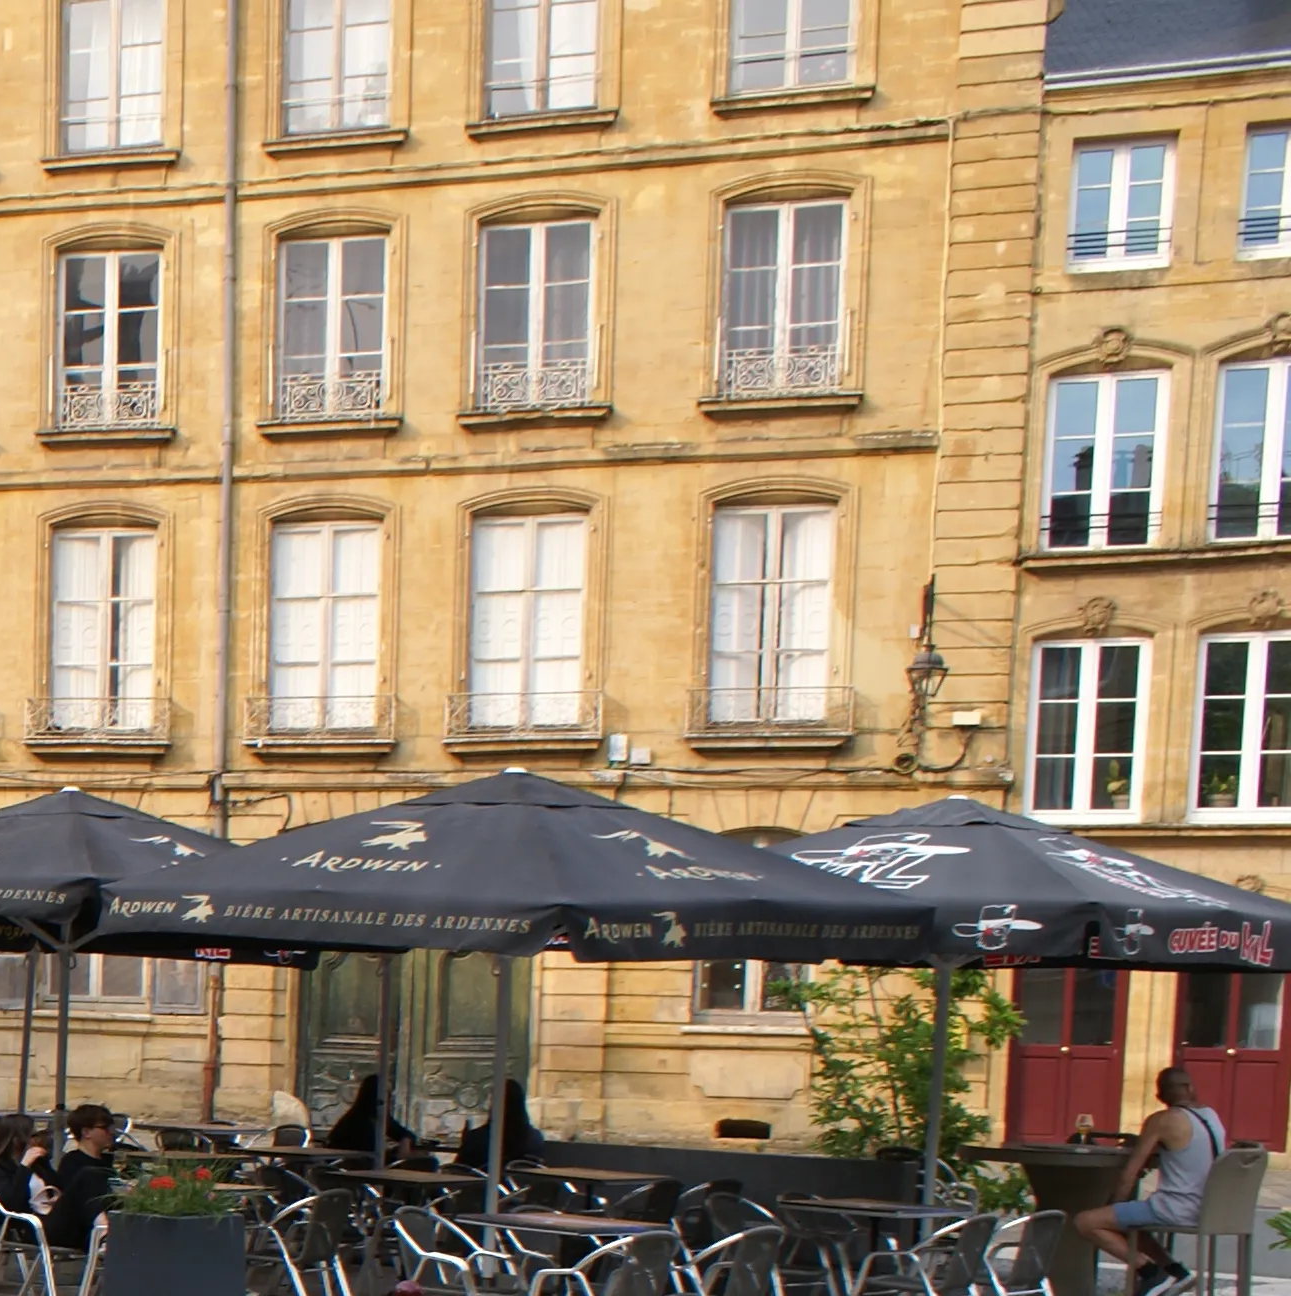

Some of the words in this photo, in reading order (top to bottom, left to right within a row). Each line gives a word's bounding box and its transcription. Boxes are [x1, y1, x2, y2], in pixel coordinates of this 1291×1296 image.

[292, 850, 428, 874] ARDWEN
[109, 896, 177, 918] ARDWEN
[223, 902, 274, 920] BIÈRE
[279, 906, 385, 926] ARTISANALE
[391, 912, 425, 928] DES
[430, 914, 531, 934] ARDENNES
[583, 916, 653, 944] ARDWEN
[1169, 921, 1218, 955] CUVÉE
[1220, 929, 1239, 950] DU
